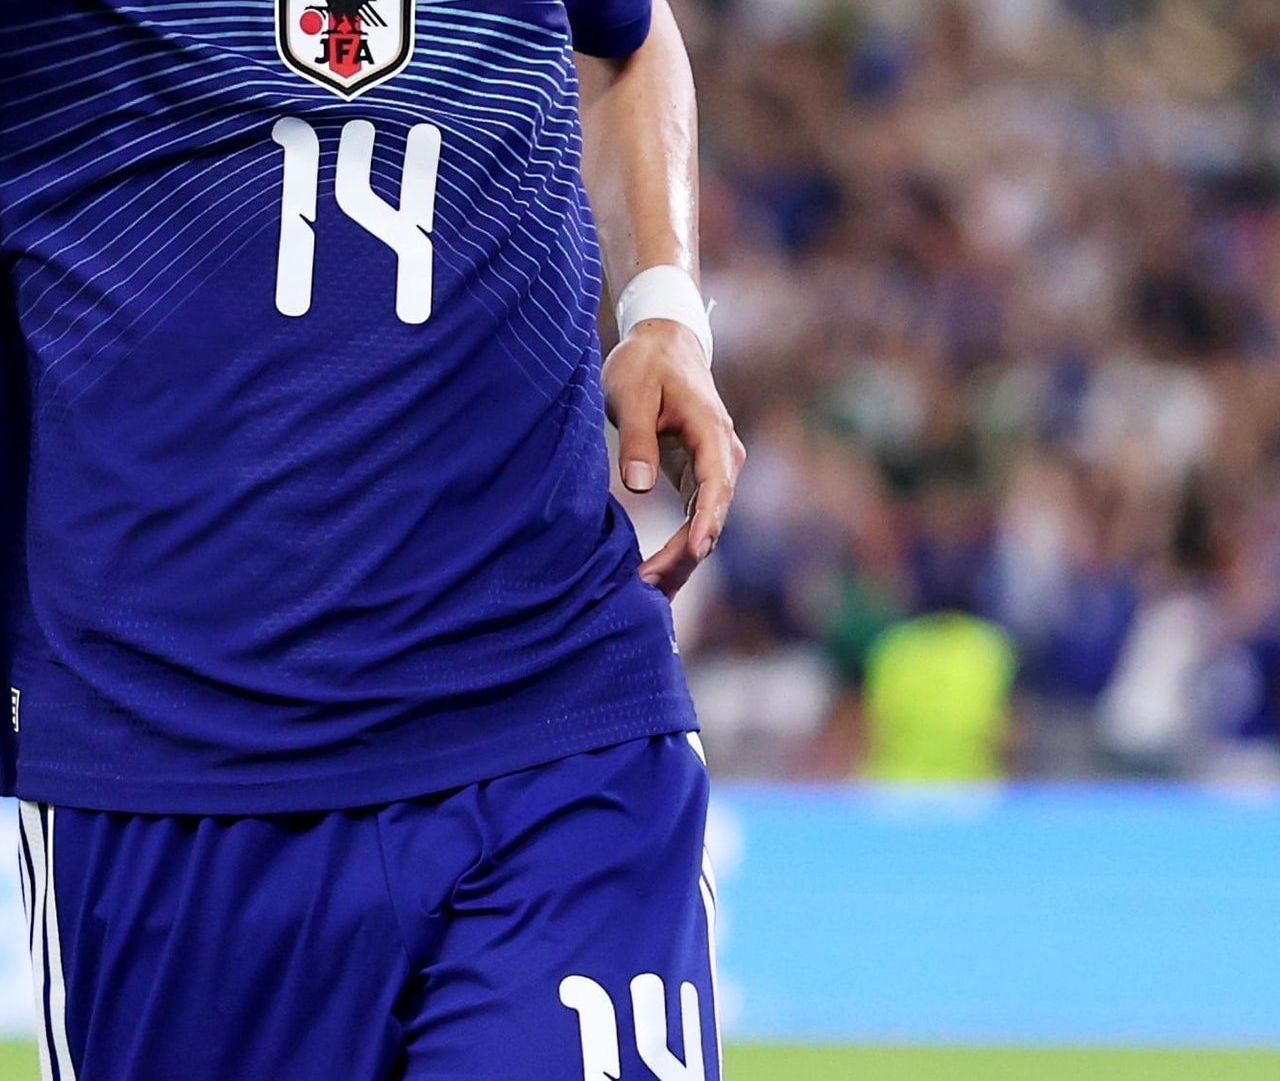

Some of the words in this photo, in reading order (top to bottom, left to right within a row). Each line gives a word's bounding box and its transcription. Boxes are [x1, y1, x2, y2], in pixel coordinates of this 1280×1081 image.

[314, 38, 375, 65] JFA
[271, 116, 442, 325] 14
[558, 973, 707, 1081] 14
